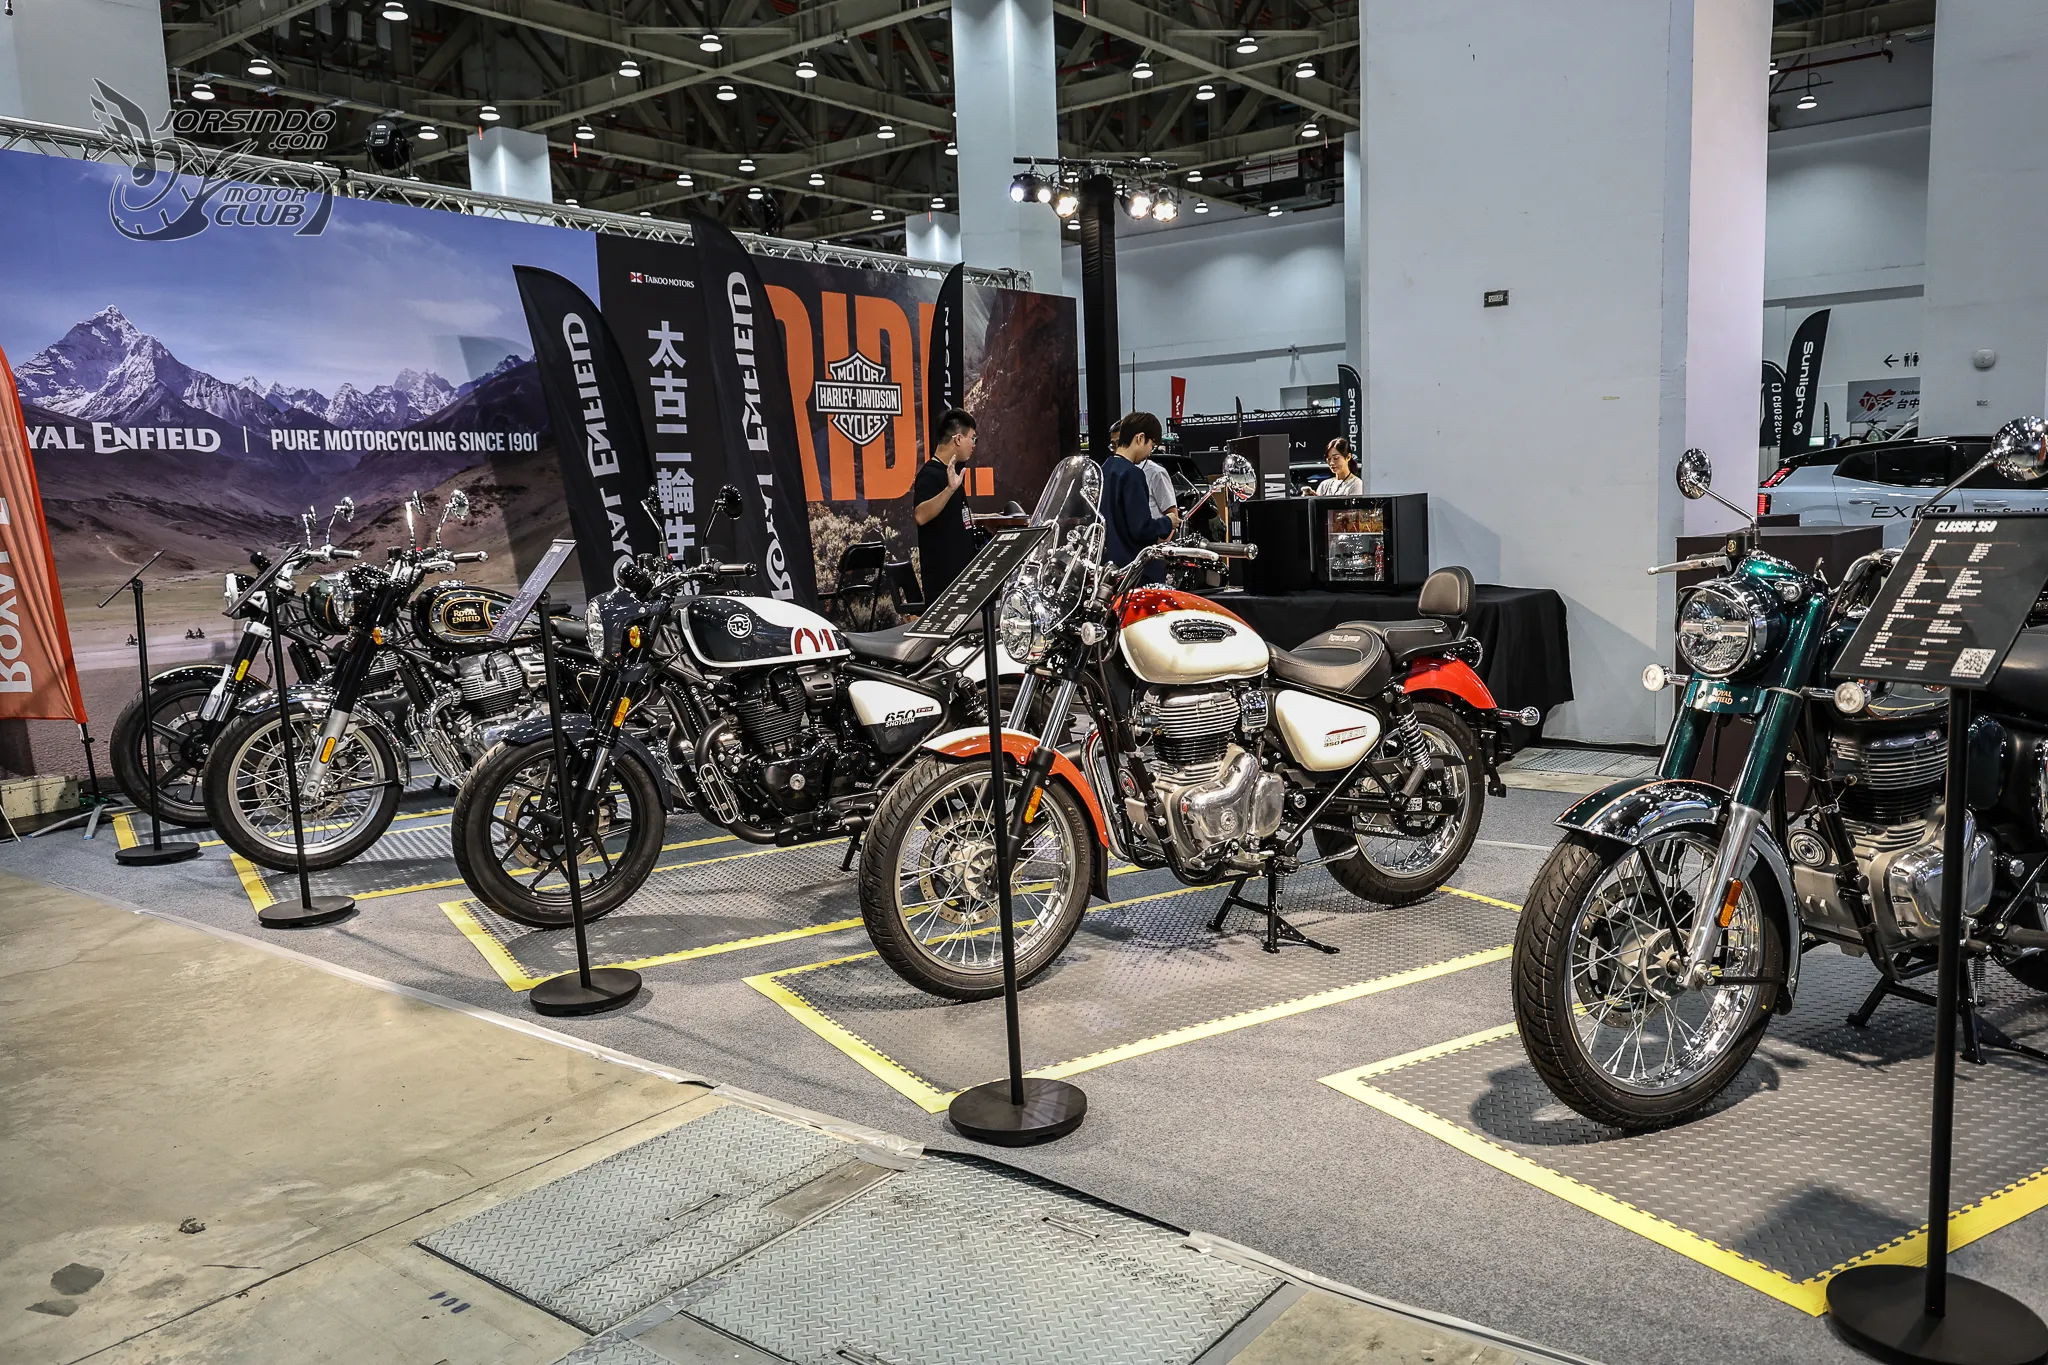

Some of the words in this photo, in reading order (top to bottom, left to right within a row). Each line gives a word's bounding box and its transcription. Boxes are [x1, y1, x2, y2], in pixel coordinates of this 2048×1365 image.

[838, 359, 879, 382] MOTOR
[1795, 341, 1814, 419] Sunlight
[820, 386, 898, 409] HARLEY-DAVIDSON
[1897, 398, 1920, 409] 台中
[840, 414, 881, 440] CYCLES
[26, 426, 84, 449] YAL
[92, 421, 221, 454] ENFIELD
[271, 428, 321, 450] PURE
[324, 429, 456, 451] MOTORCYCLING
[459, 431, 505, 451] SINCE
[508, 432, 538, 451] 1901
[1935, 521, 1977, 532] CLASSIC
[1975, 521, 1998, 532] 350
[452, 615, 481, 623] ENFIELD
[453, 608, 477, 617] ROYAL
[885, 709, 915, 722] 650
[885, 717, 915, 728] SHOTGUN
